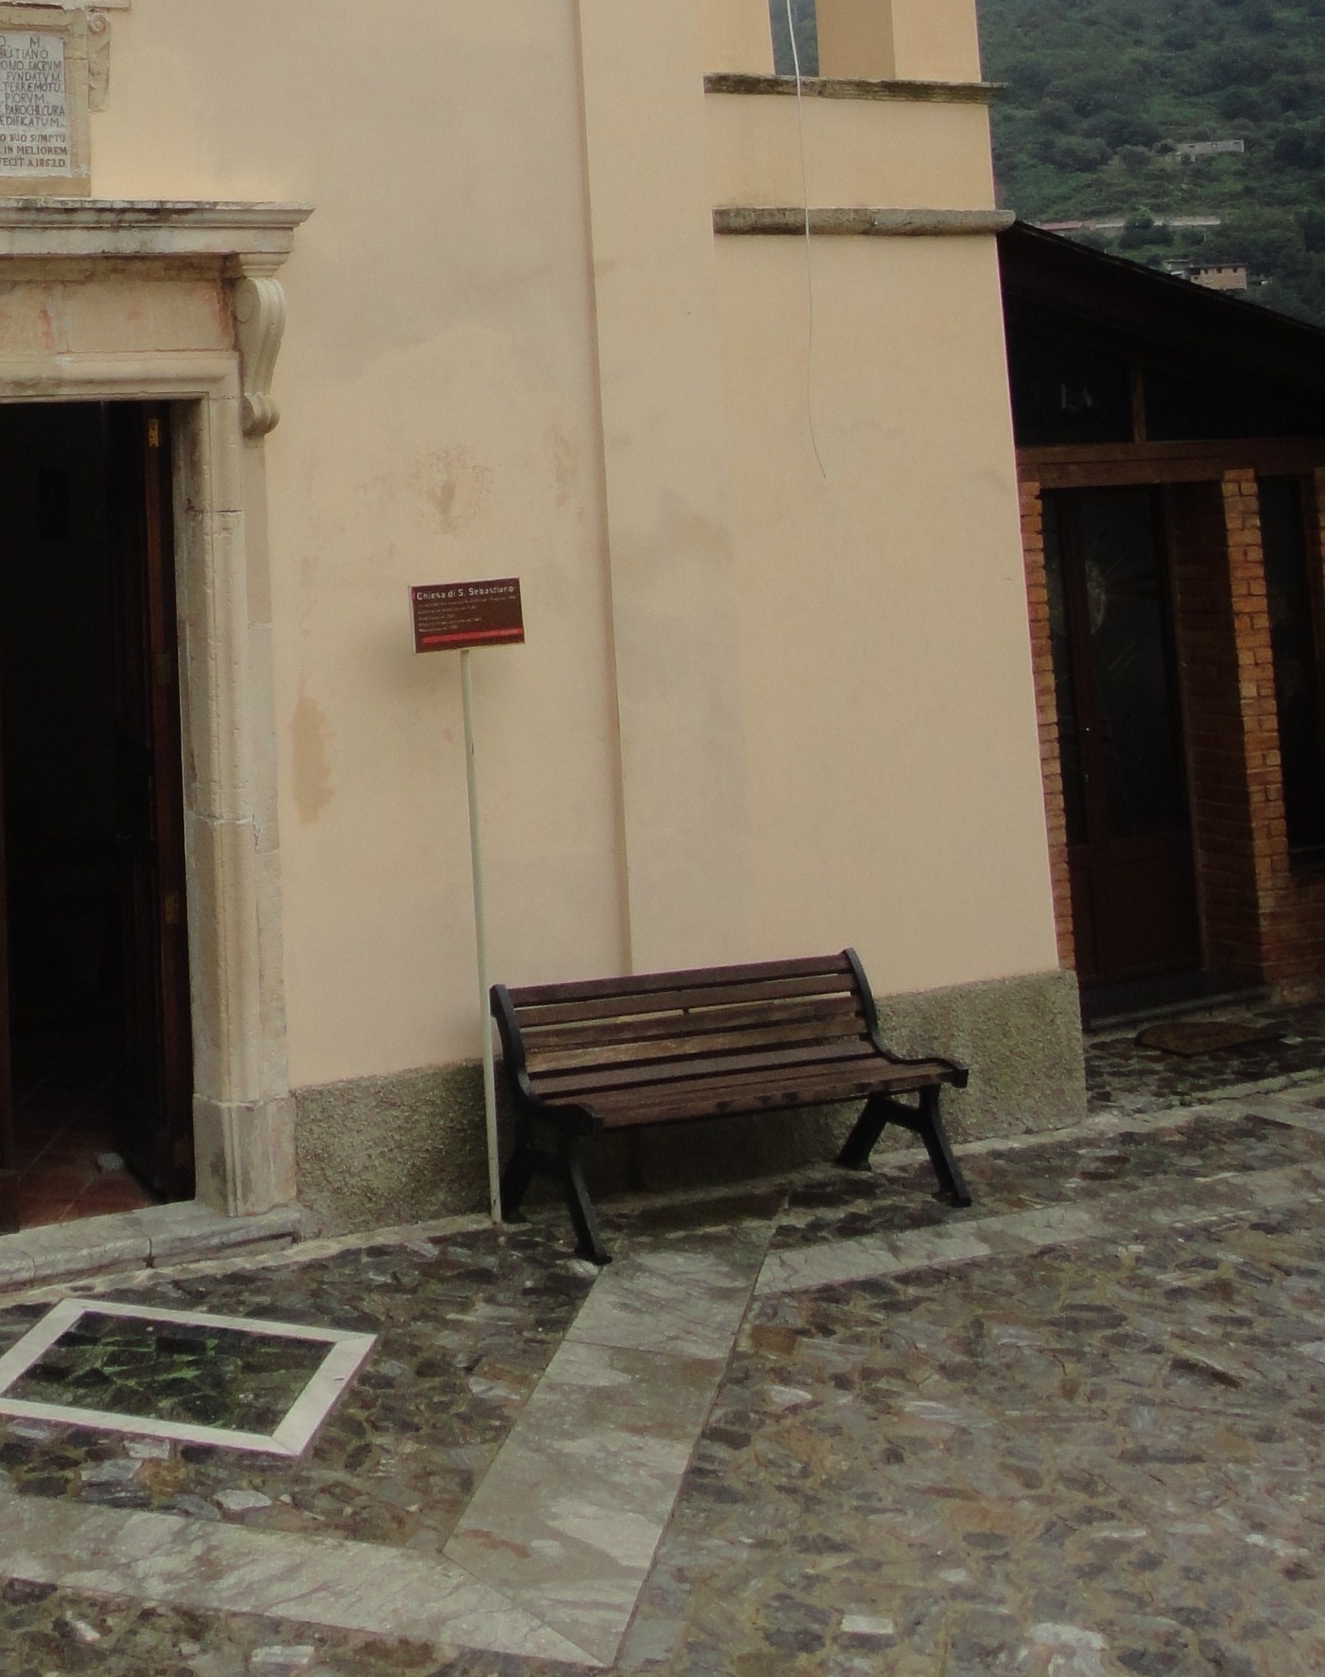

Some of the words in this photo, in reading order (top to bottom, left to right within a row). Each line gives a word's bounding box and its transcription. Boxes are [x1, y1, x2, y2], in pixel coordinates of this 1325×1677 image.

[9, 133, 27, 142] SUO
[4, 145, 14, 155] IN
[16, 145, 67, 155] MELIOREM
[416, 591, 446, 601] Chiesa
[468, 585, 515, 596] Sebastiano
